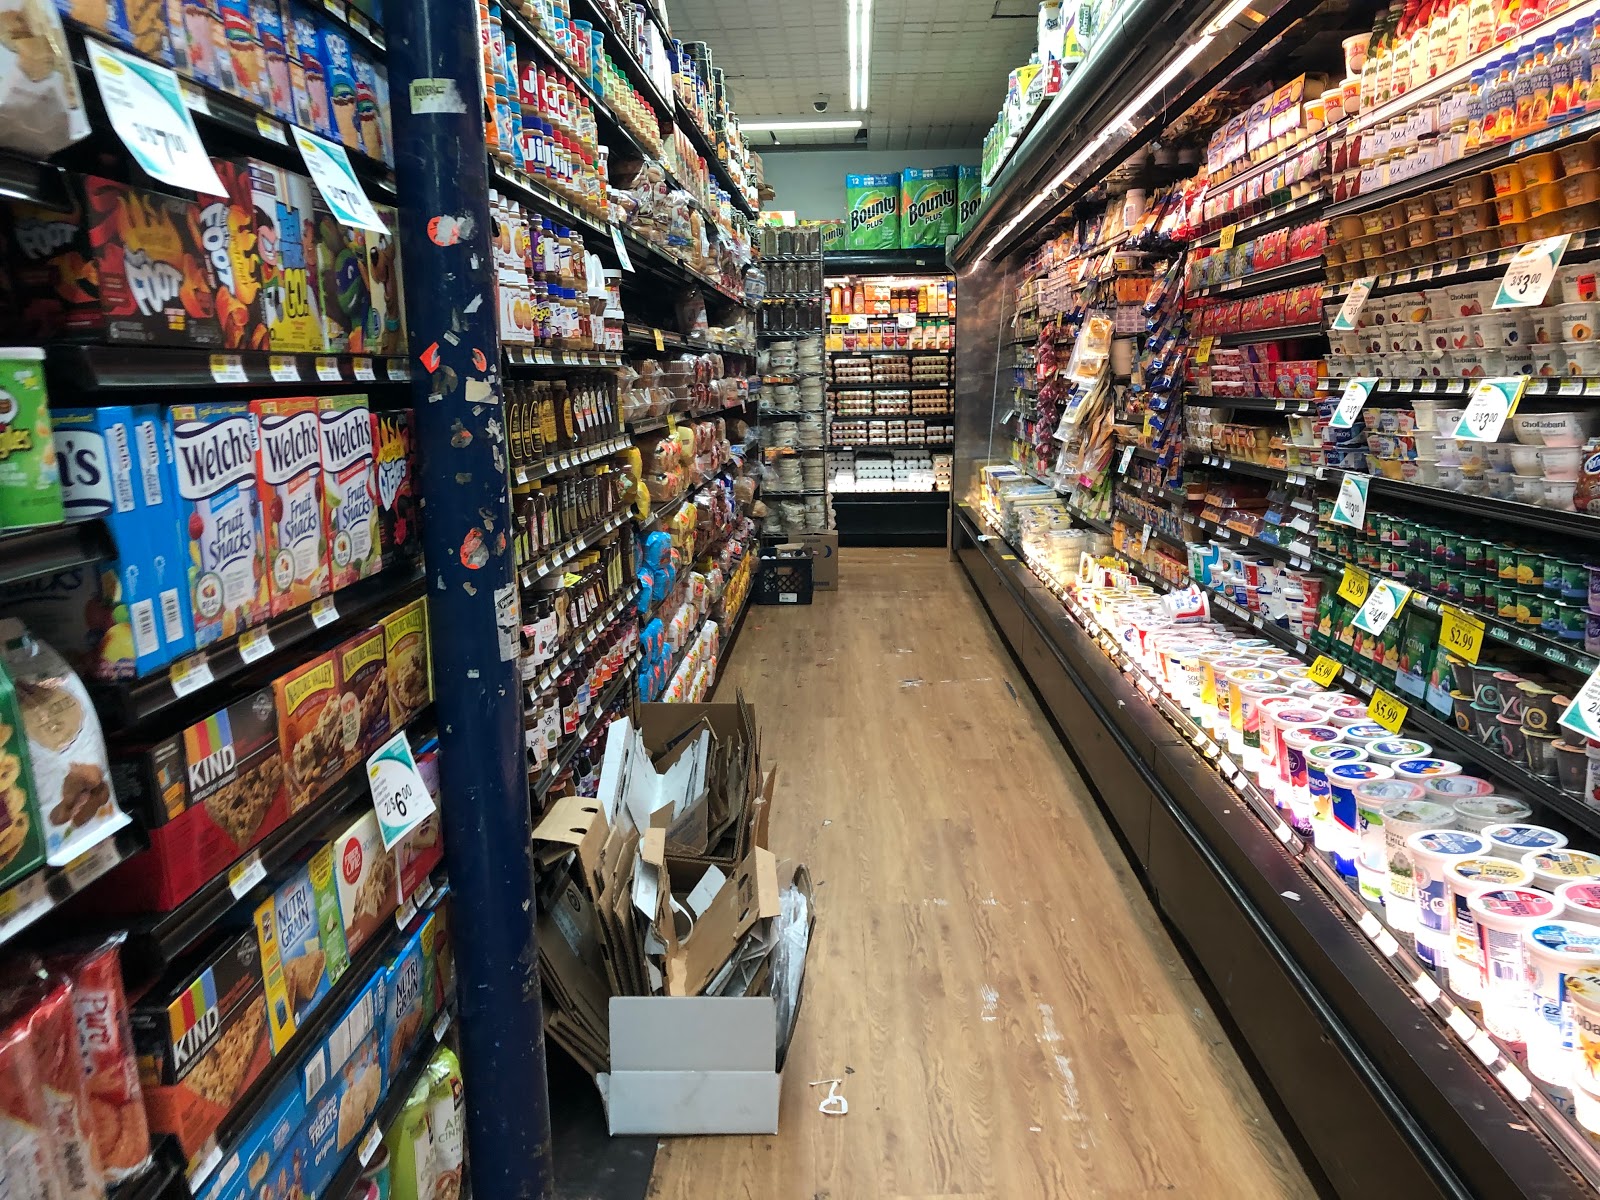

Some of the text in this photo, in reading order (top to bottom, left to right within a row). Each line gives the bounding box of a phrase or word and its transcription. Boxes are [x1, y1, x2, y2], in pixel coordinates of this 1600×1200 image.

[850, 195, 896, 233] Bounty
[866, 219, 883, 231] PLUS
[908, 188, 955, 227] Bounty
[925, 212, 943, 225] PLUS
[285, 267, 309, 318] GO!
[179, 426, 253, 487] Welch's
[264, 419, 318, 473] Welch's
[323, 415, 371, 465] Welch's
[290, 492, 312, 520] Fruit
[342, 496, 371, 529] Snacks
[347, 480, 366, 507] Fruit
[216, 507, 245, 544] Fruit
[284, 511, 318, 548] Snacks
[209, 528, 252, 571] Snacks
[1346, 580, 1365, 598] $2.99
[1450, 626, 1474, 652] $2.99
[1312, 664, 1332, 679] $5.99
[1373, 698, 1399, 724] $5.99
[188, 744, 236, 793] KIND
[278, 885, 307, 926] NUTRI
[1433, 900, 1445, 908] 16
[280, 901, 311, 949] GRAIN
[395, 957, 419, 999] NUTRI
[395, 974, 419, 1020] GRAIN
[173, 1004, 220, 1071] KIND
